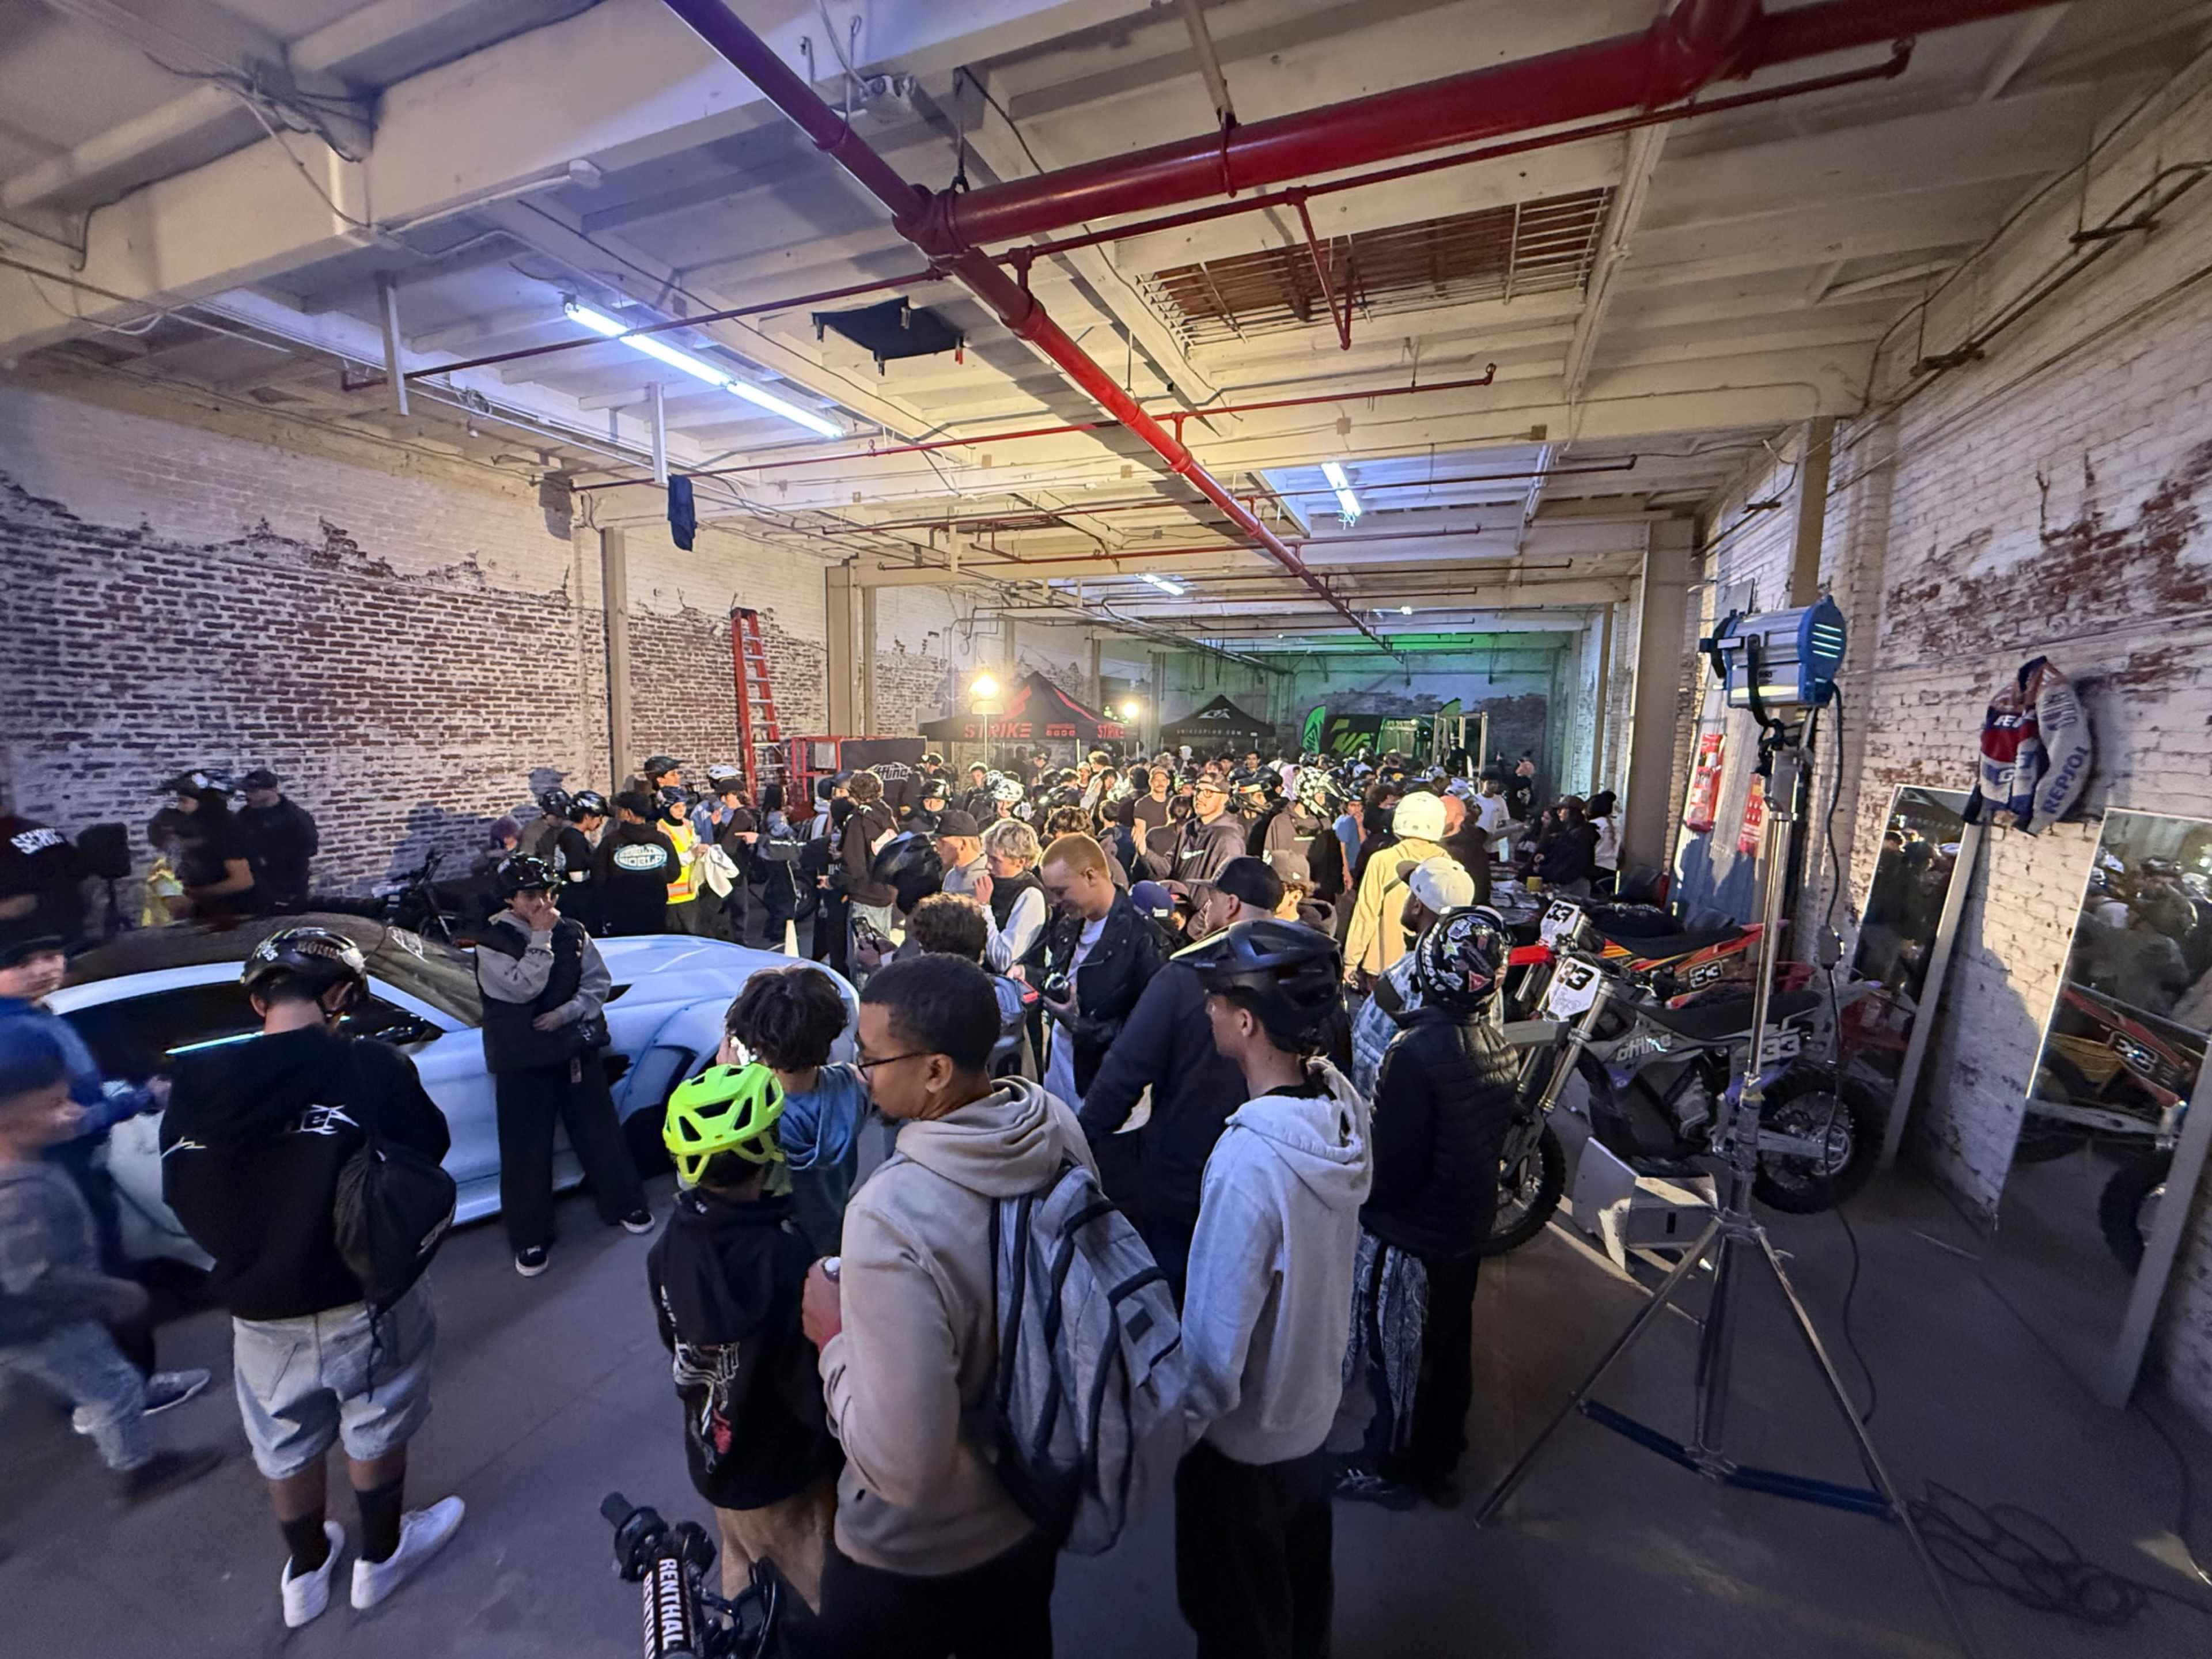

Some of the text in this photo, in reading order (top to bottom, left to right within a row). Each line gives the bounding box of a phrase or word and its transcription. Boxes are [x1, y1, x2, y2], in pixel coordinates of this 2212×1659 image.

[964, 723, 1032, 738] STRIKE
[1097, 724, 1124, 738] STRIKE
[1546, 903, 1575, 923] 33
[1556, 961, 1595, 991] 33
[1689, 960, 1724, 988] 33
[1760, 1035, 1800, 1062] 33
[658, 1558, 684, 1650] RENTHAL
